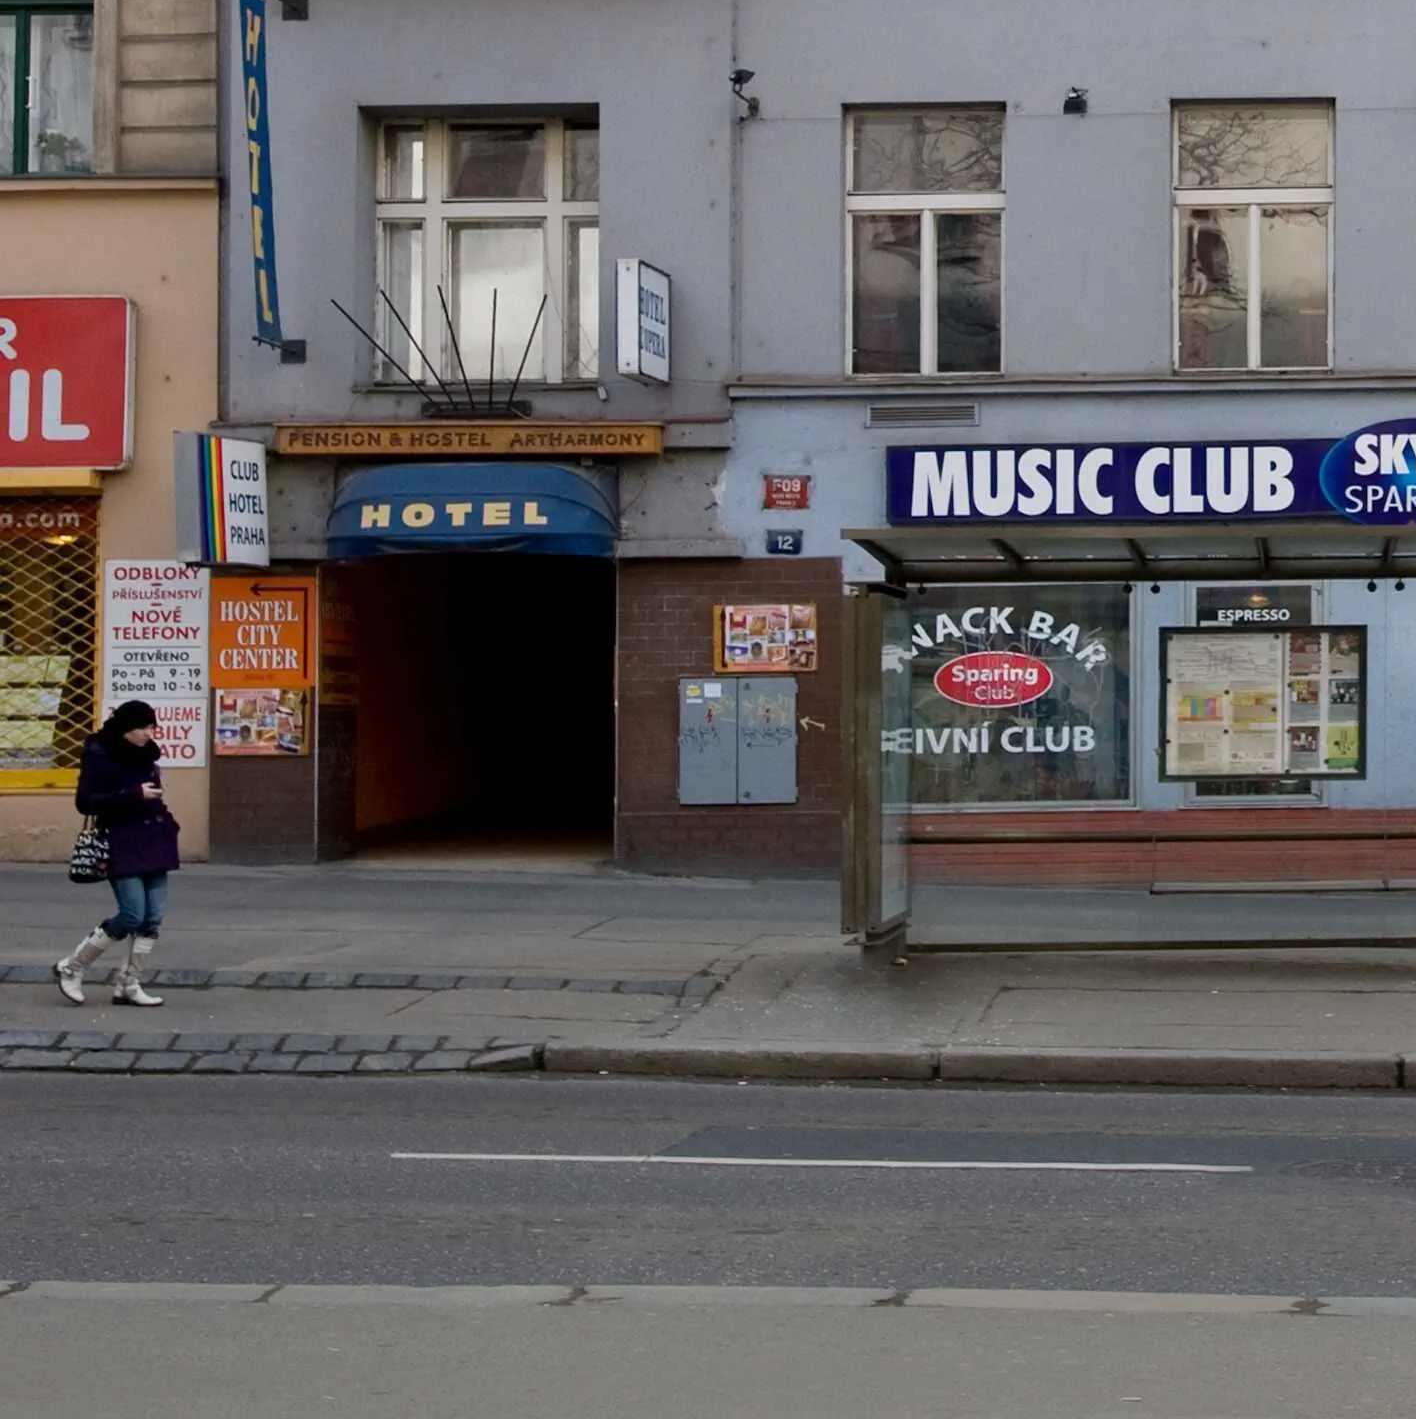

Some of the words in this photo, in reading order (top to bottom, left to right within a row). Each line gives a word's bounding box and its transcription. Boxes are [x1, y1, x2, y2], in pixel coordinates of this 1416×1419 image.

[246, 8, 274, 325] HOTEL
[288, 432, 381, 448] PENSION
[389, 433, 403, 447] &
[409, 432, 492, 448] HOSTEL
[230, 459, 260, 482] CLUB
[910, 447, 1114, 518] MUSIC
[1134, 446, 1295, 514] CLUB
[229, 492, 265, 515] HOTEL
[360, 501, 549, 529] HOTEL
[230, 525, 266, 547] PRAHA
[777, 535, 794, 550] 12
[113, 566, 200, 581] ODBLOKY
[112, 588, 203, 600] PŘÍSLUŠENSTVÍ
[131, 606, 182, 623] NOVÉ
[219, 600, 299, 622] HOSTEL
[1217, 608, 1290, 622] ESPRESSO
[112, 626, 200, 641] TELEFONY
[236, 624, 282, 646] CITY
[1028, 610, 1108, 672] BAR
[123, 650, 190, 663] OTEVŘENO
[219, 648, 299, 670] CENTER
[112, 668, 128, 679] Po
[169, 668, 177, 679] 9
[188, 668, 201, 679] 19
[951, 663, 1039, 686] Sparing
[112, 682, 156, 692] Sobota
[163, 682, 177, 692] 10
[188, 682, 202, 692] 16
[974, 685, 1016, 701] Club
[881, 721, 989, 755] IVNÍ
[1001, 725, 1096, 754] CLUB
